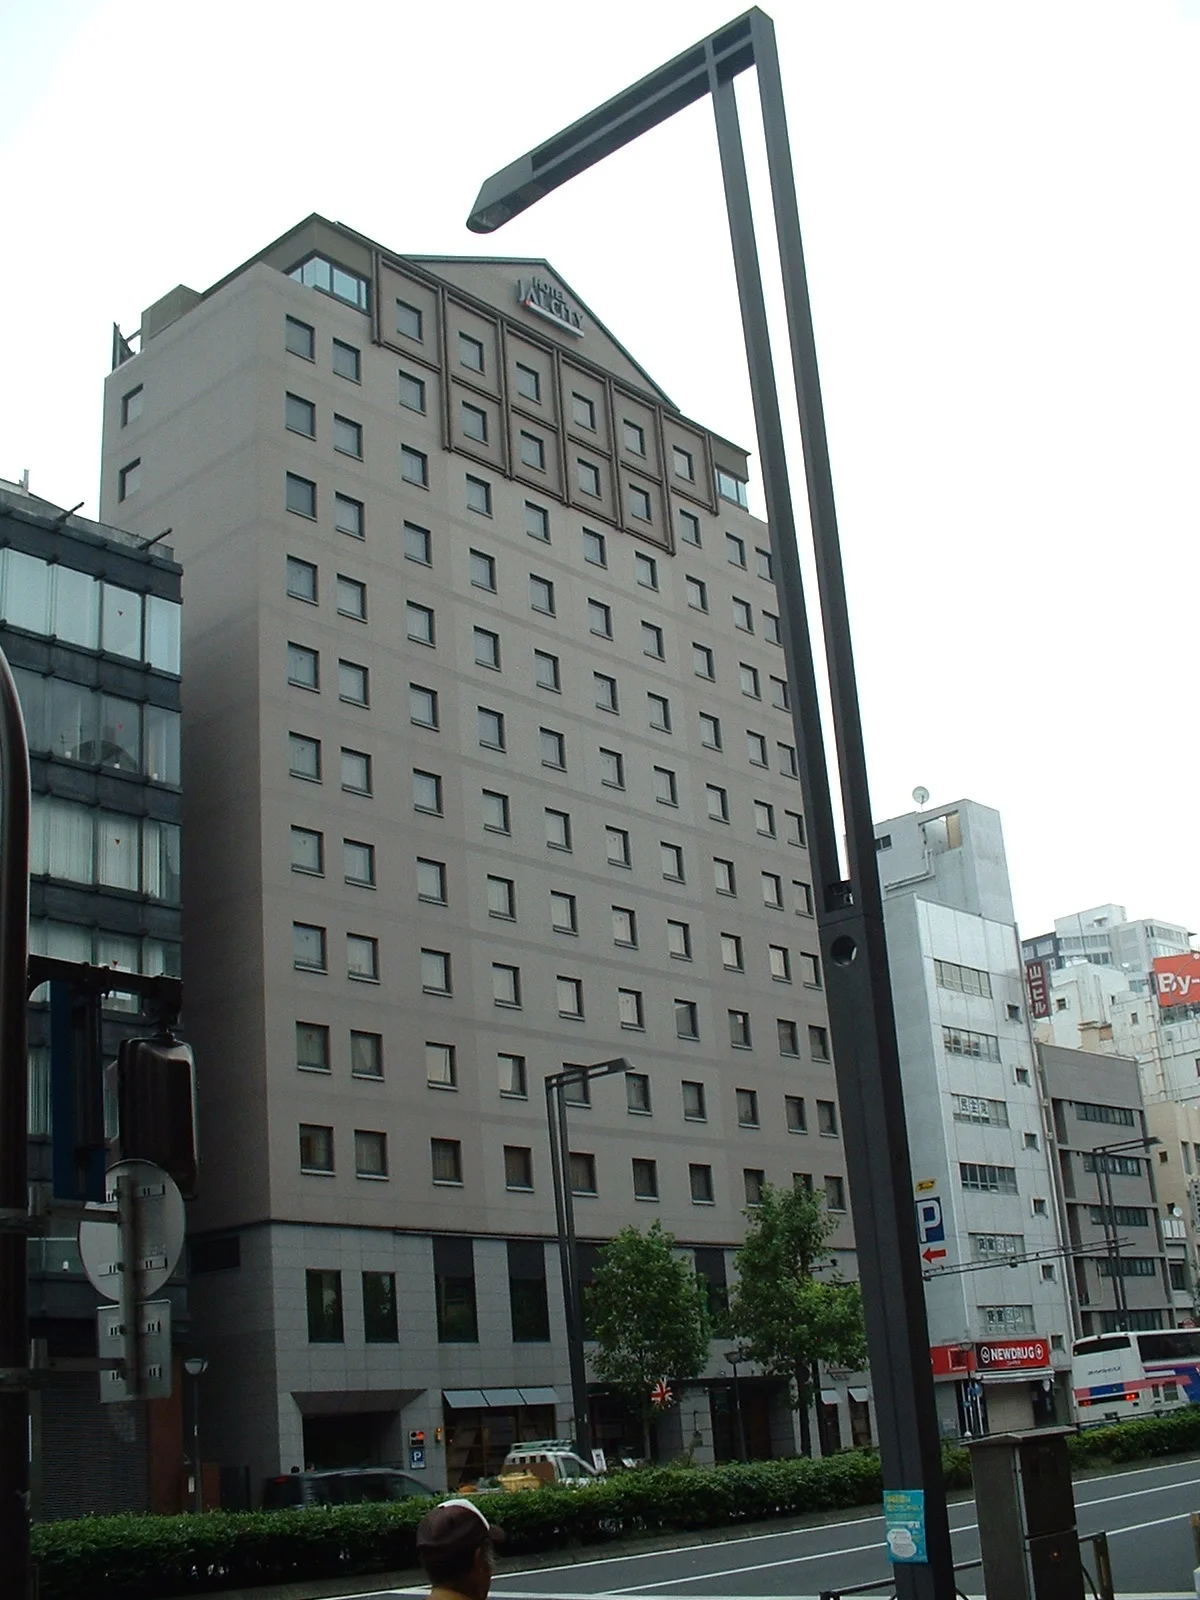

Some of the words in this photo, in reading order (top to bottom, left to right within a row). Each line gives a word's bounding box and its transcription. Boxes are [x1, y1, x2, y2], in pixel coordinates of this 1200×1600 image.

[916, 1199, 941, 1242] P
[990, 1346, 1036, 1361] NEWDRUG
[413, 1451, 422, 1461] P
